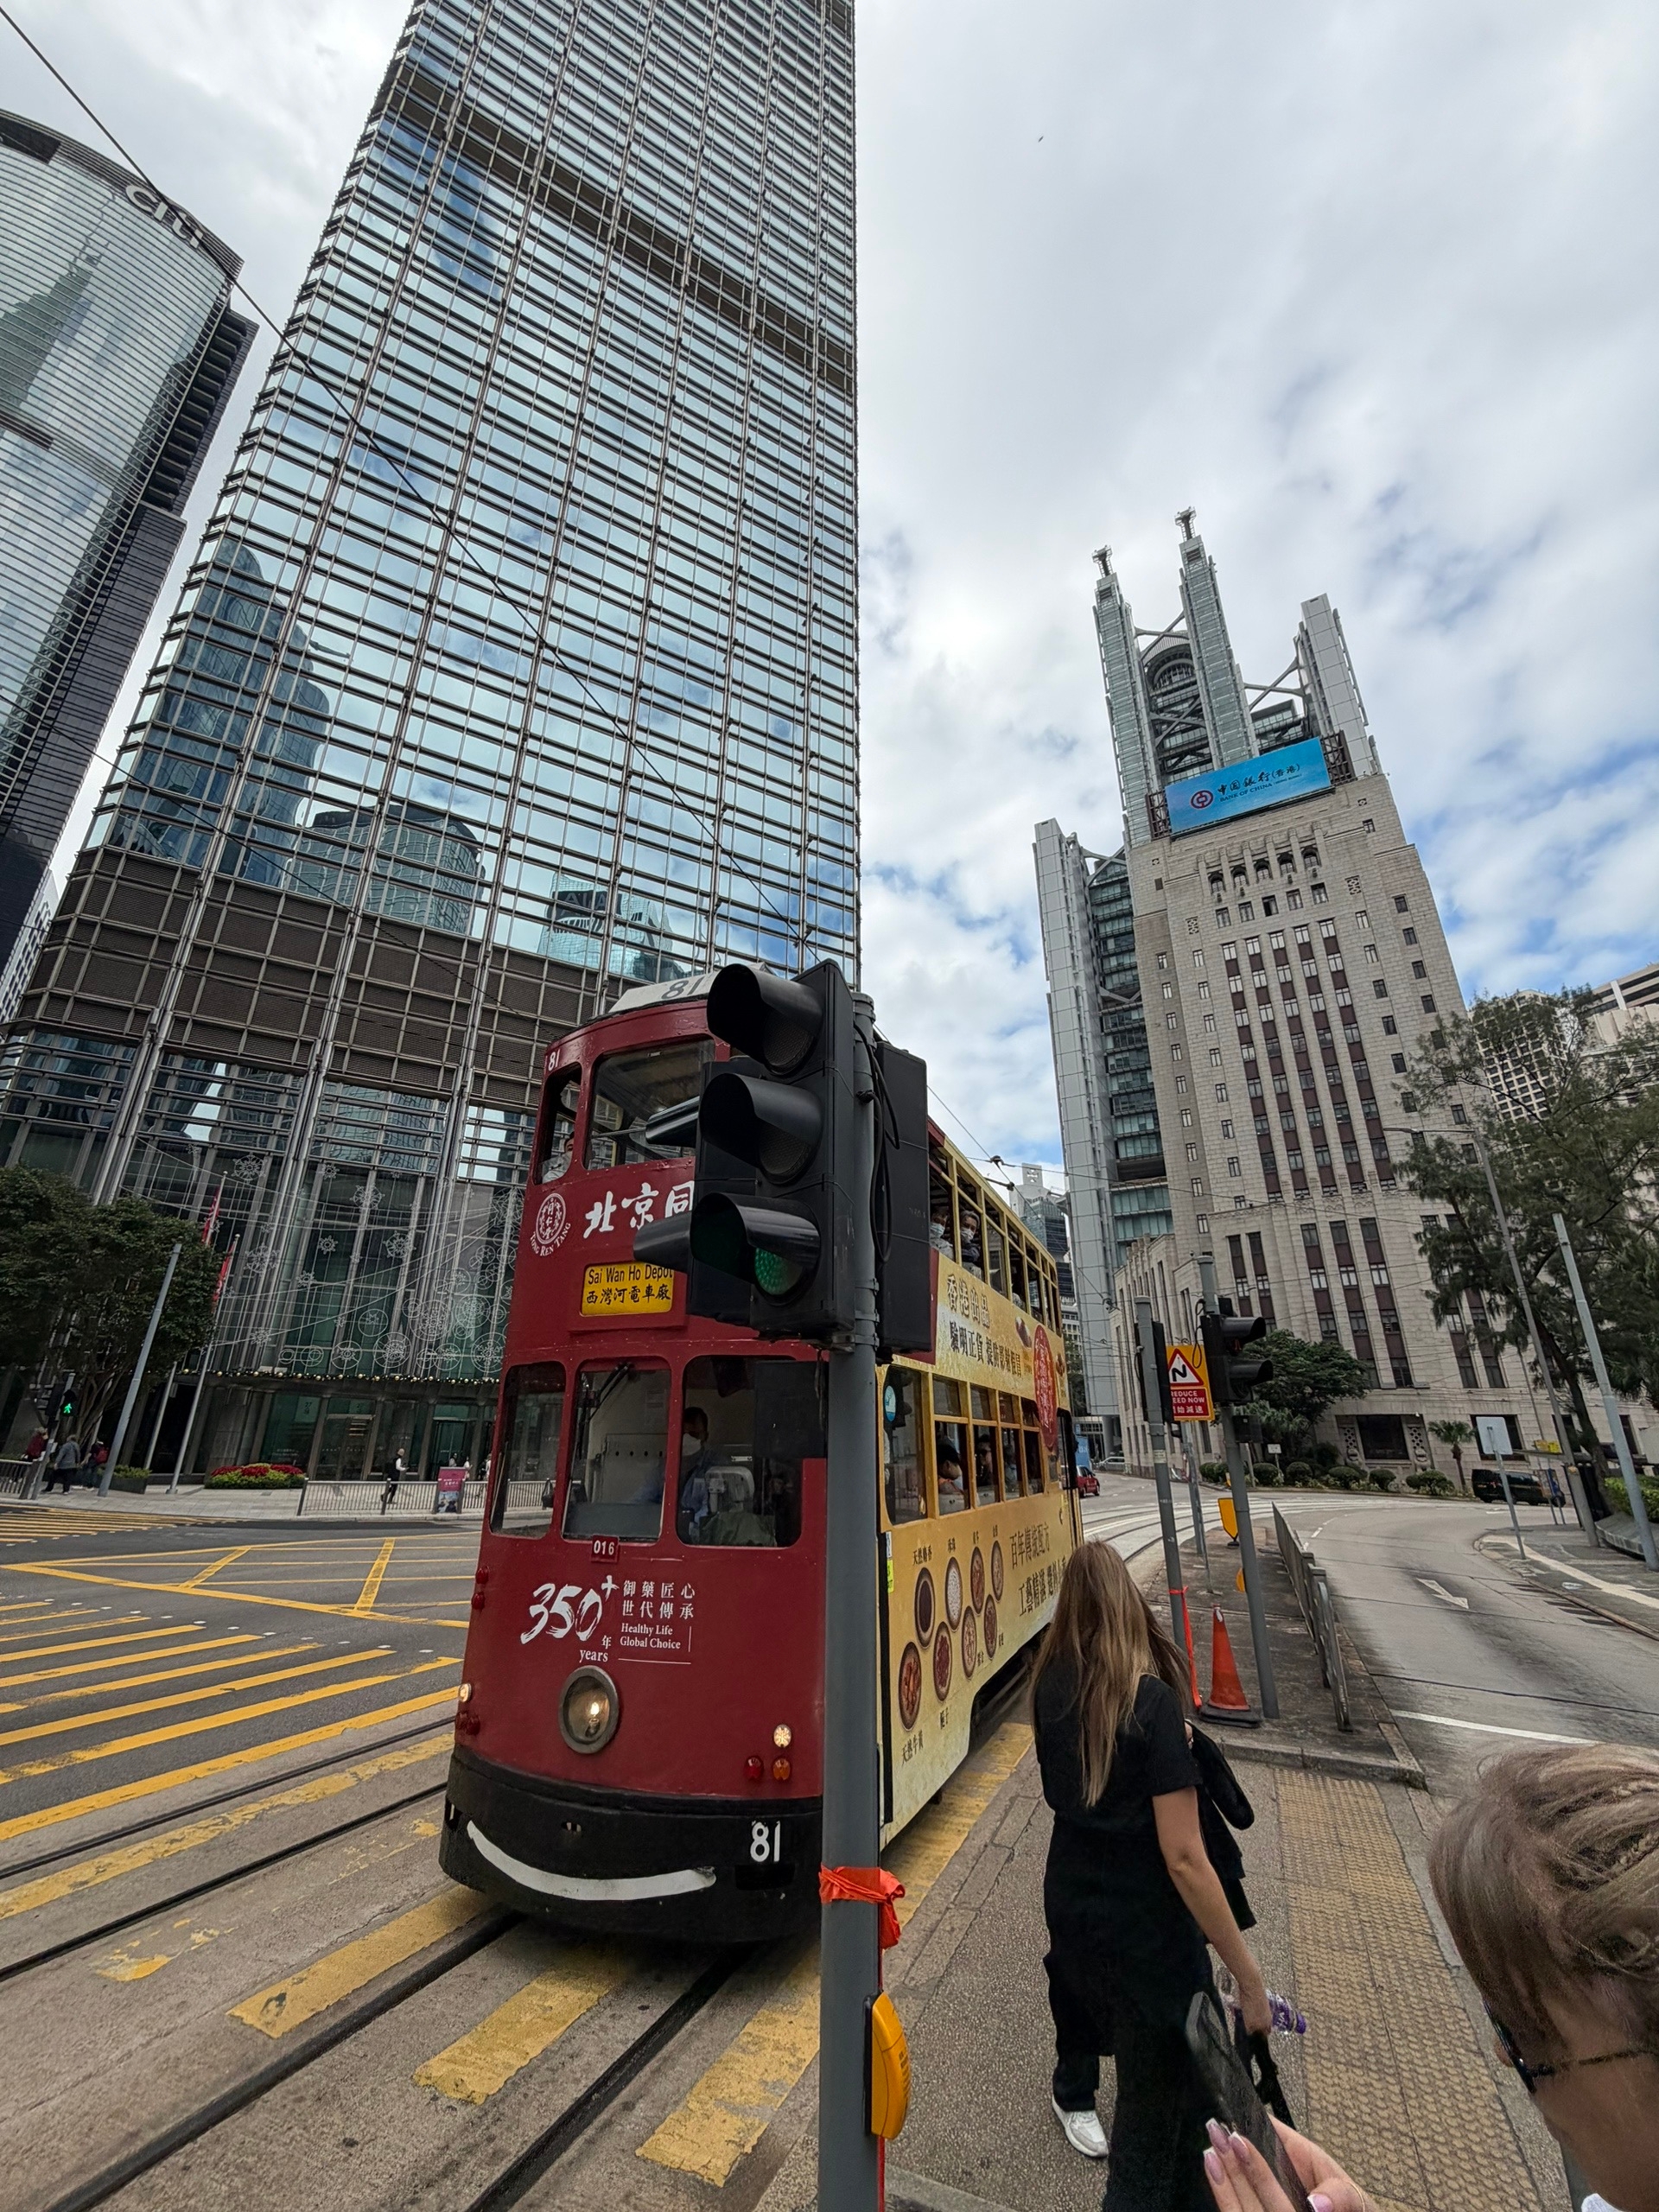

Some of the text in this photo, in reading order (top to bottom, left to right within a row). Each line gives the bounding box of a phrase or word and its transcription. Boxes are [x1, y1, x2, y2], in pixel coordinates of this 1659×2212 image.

[1219, 793, 1239, 802] BANK
[1249, 783, 1273, 793] CHINA
[661, 976, 704, 1000] 81
[548, 1049, 561, 1071] 81
[540, 1245, 554, 1257] REN
[554, 1222, 571, 1248] TANG
[588, 1264, 673, 1285] Sai Wan Ho Depot
[586, 1284, 671, 1305] 西灣河電車廠
[594, 1540, 614, 1555] 016
[623, 1580, 695, 1599] 御藥匠心
[622, 1599, 694, 1620] 世代傳承
[621, 1623, 673, 1637] Healthy Life
[601, 1636, 612, 1649] 年
[620, 1636, 681, 1649] Global Choice
[579, 1649, 608, 1663] years
[750, 1820, 781, 1862] 81
